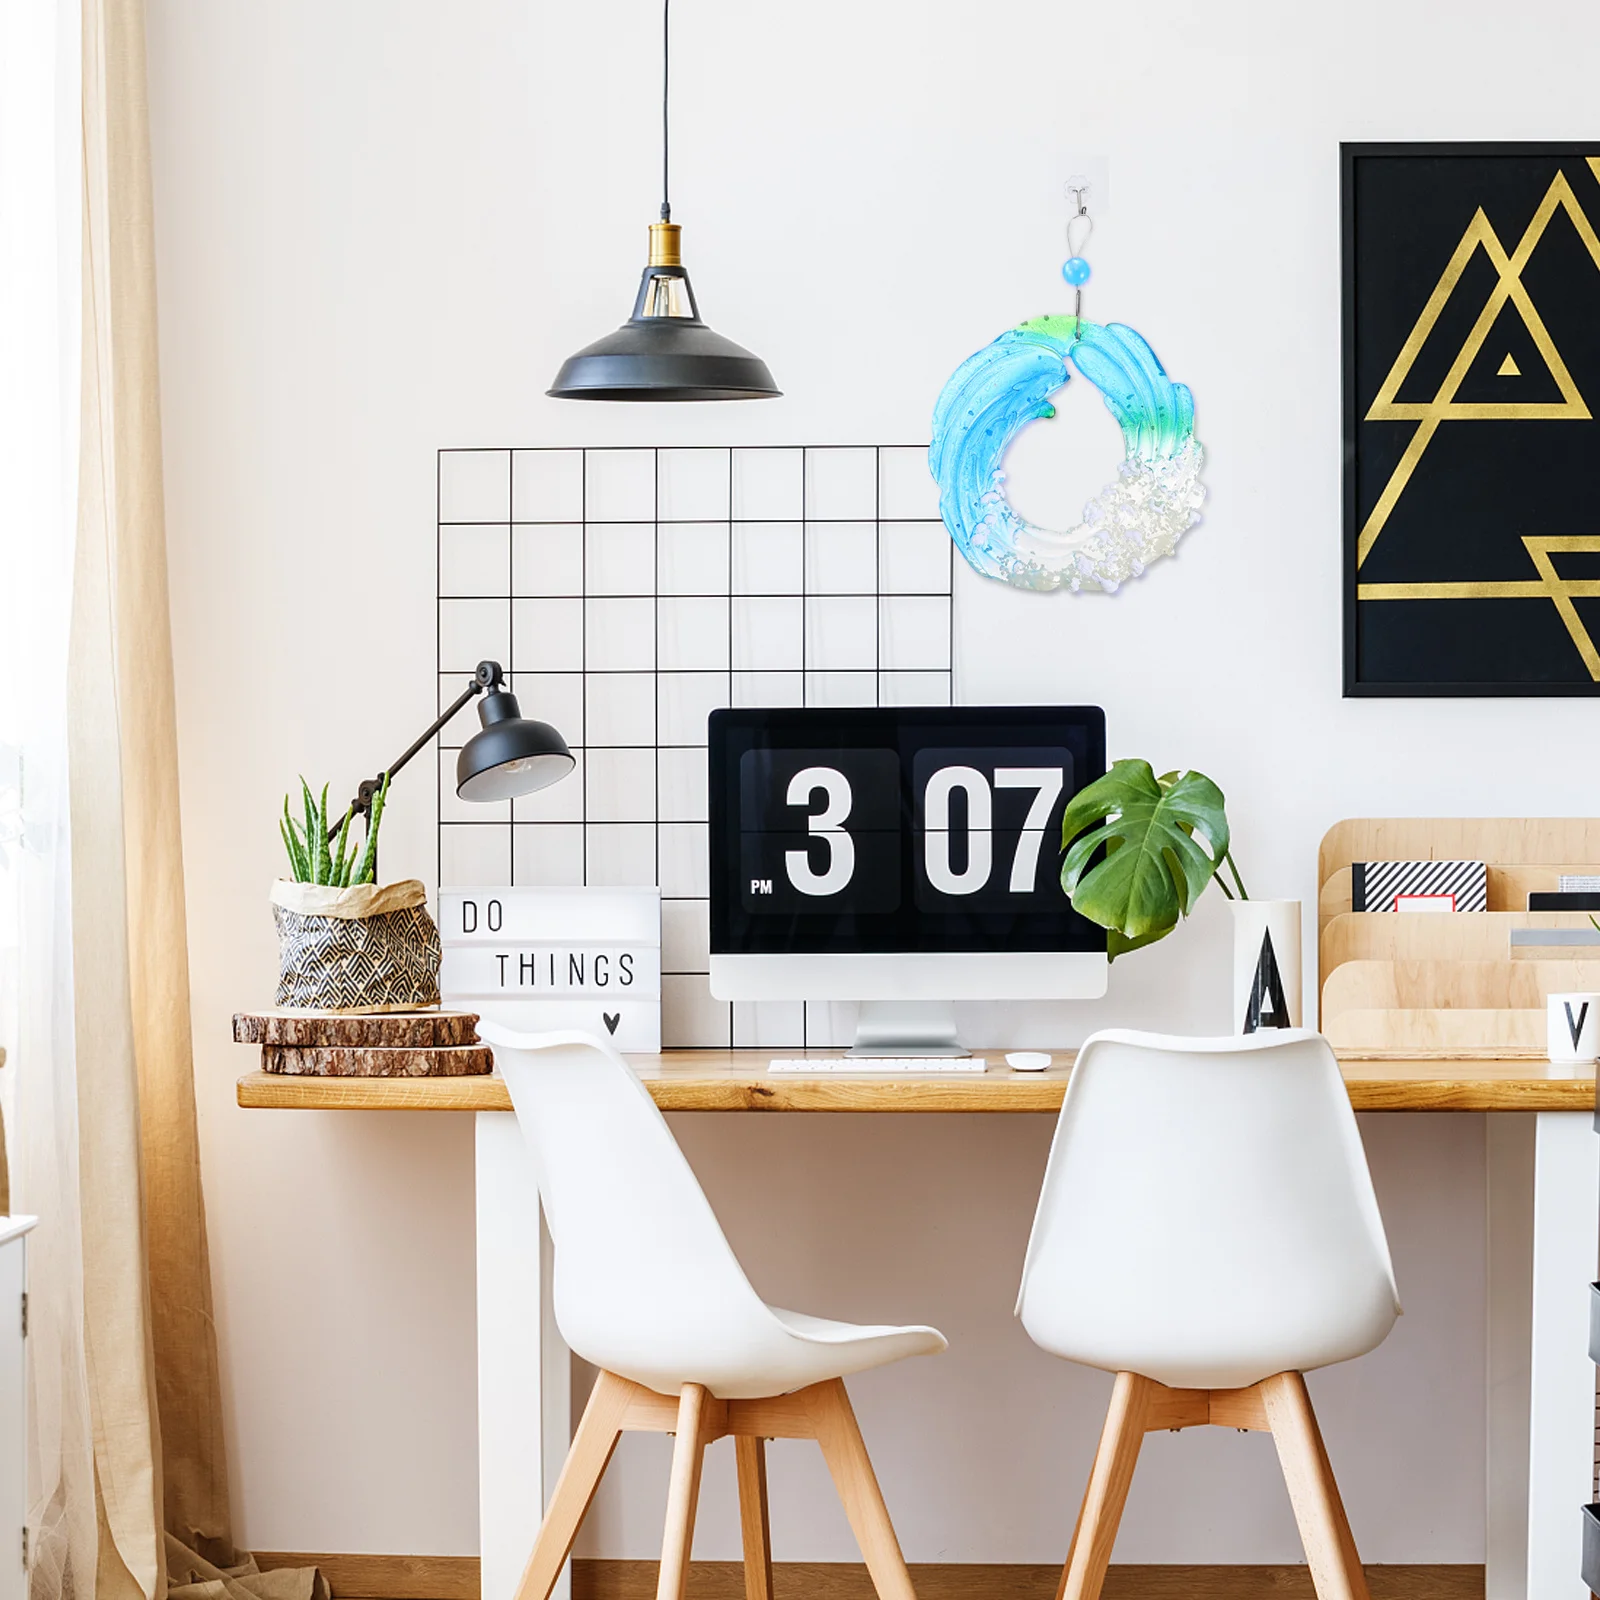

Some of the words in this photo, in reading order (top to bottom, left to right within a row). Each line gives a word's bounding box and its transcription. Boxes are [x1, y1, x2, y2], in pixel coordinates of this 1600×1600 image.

[785, 766, 855, 896] 3
[924, 766, 1064, 896] 07
[750, 879, 773, 895] PM
[462, 899, 503, 934] DO
[495, 953, 634, 987] THINGS
[1243, 924, 1292, 1035] A
[1563, 1001, 1589, 1053] V
